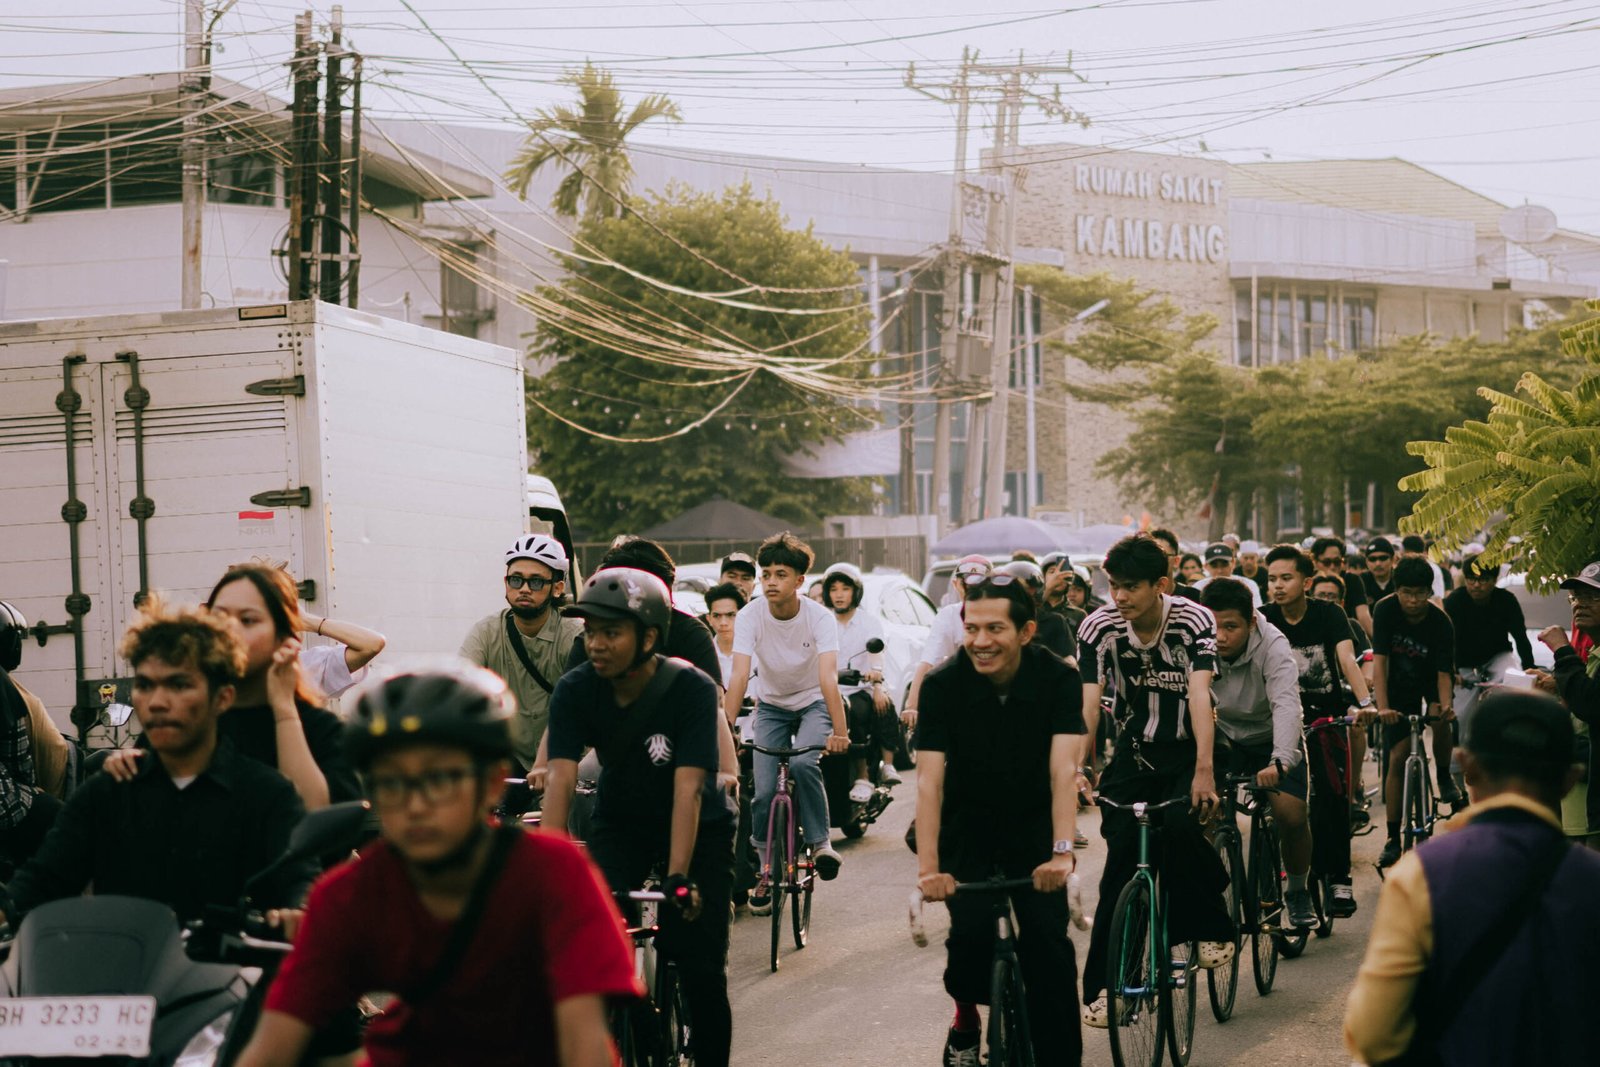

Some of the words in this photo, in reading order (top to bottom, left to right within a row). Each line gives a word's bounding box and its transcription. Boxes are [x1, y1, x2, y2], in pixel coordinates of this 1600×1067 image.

[1074, 163, 1150, 199] RUMAH
[1159, 172, 1222, 205] SAKIT
[1075, 214, 1225, 263] KAMBANG
[40, 1004, 100, 1025] 3233
[117, 1004, 148, 1025] HC
